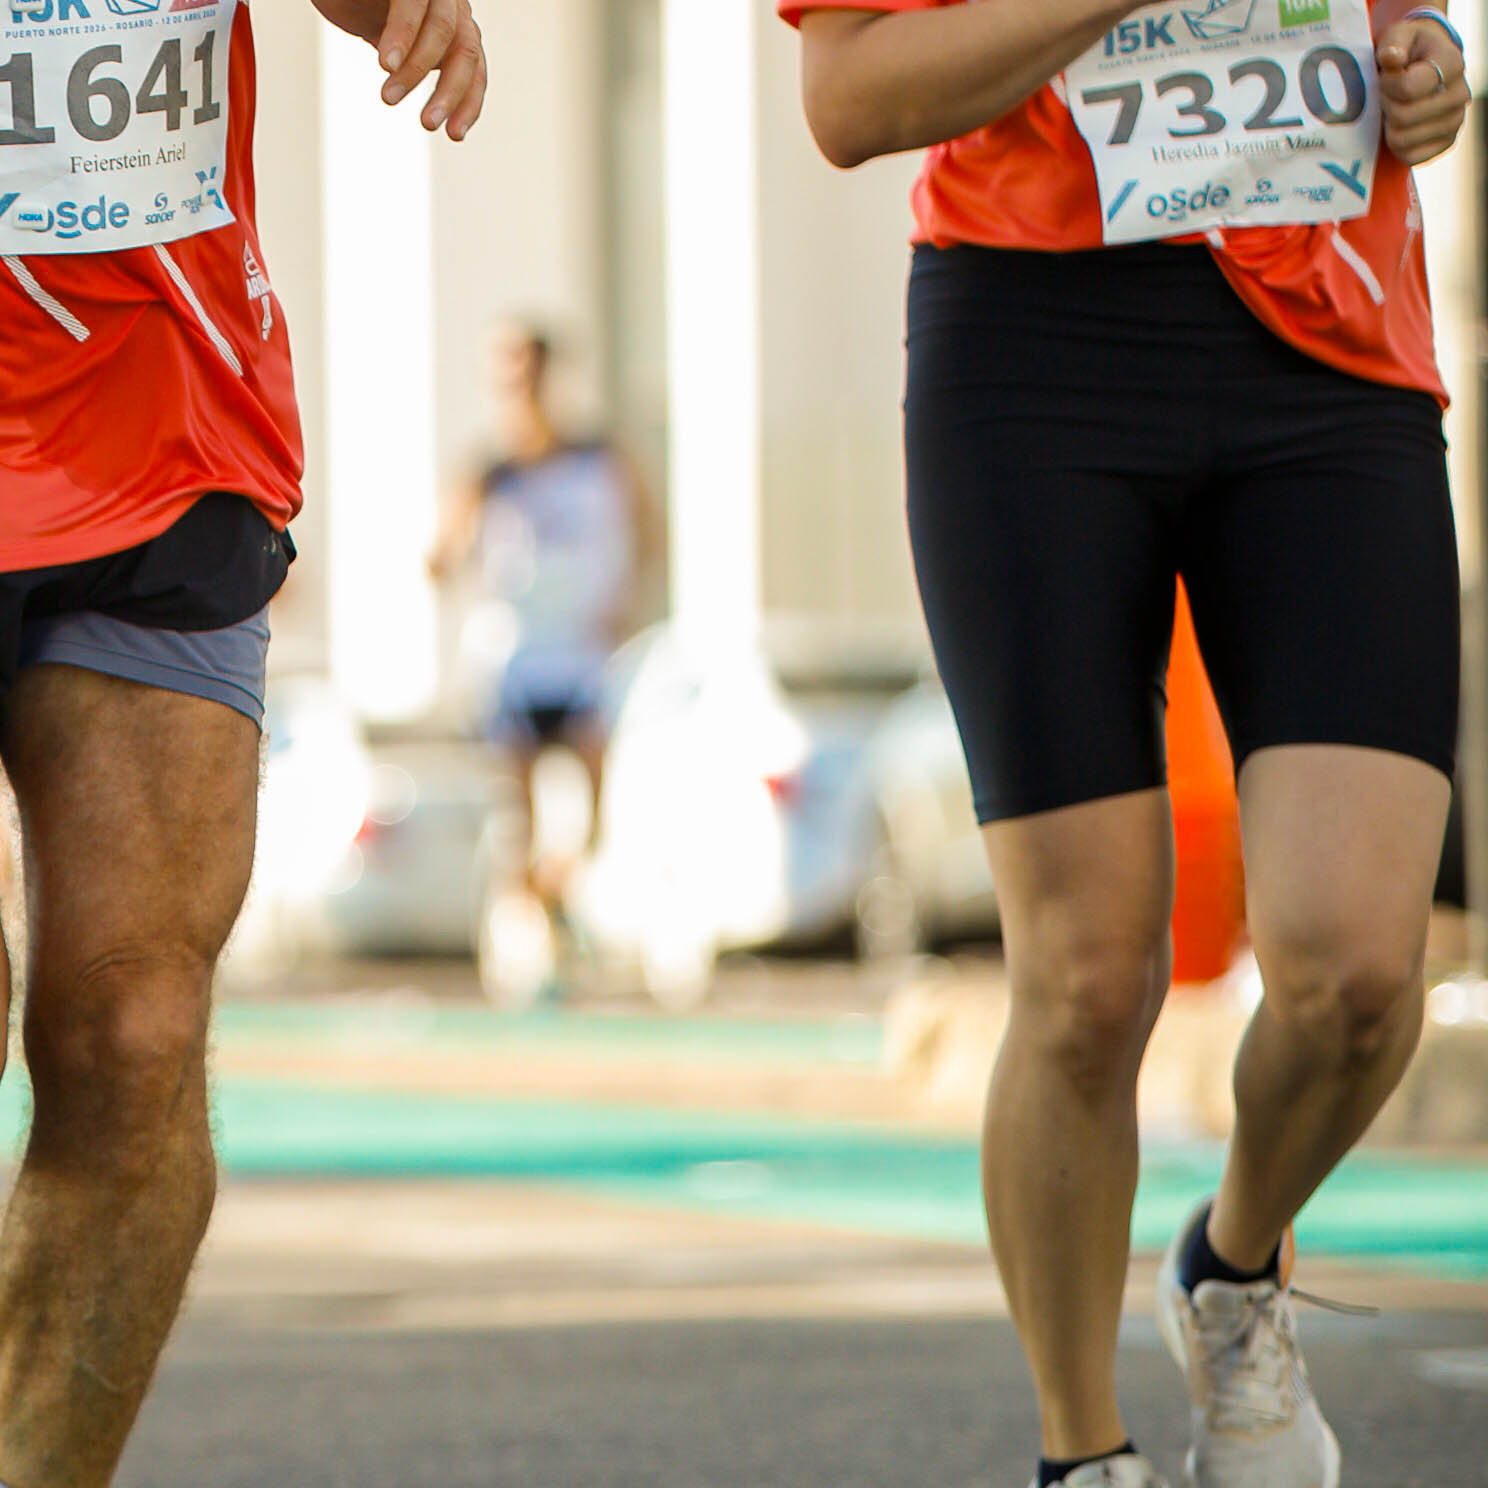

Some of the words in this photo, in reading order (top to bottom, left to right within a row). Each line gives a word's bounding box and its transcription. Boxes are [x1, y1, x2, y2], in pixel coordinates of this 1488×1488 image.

[5, 28, 45, 39] PUERTO
[48, 25, 80, 36] NORTE
[116, 18, 153, 30] ROSARIO
[1103, 14, 1177, 57] 15K
[1080, 43, 1367, 146] 7320
[70, 148, 151, 174] Feierstein
[155, 141, 187, 166] Ariel
[1146, 179, 1231, 217] osde
